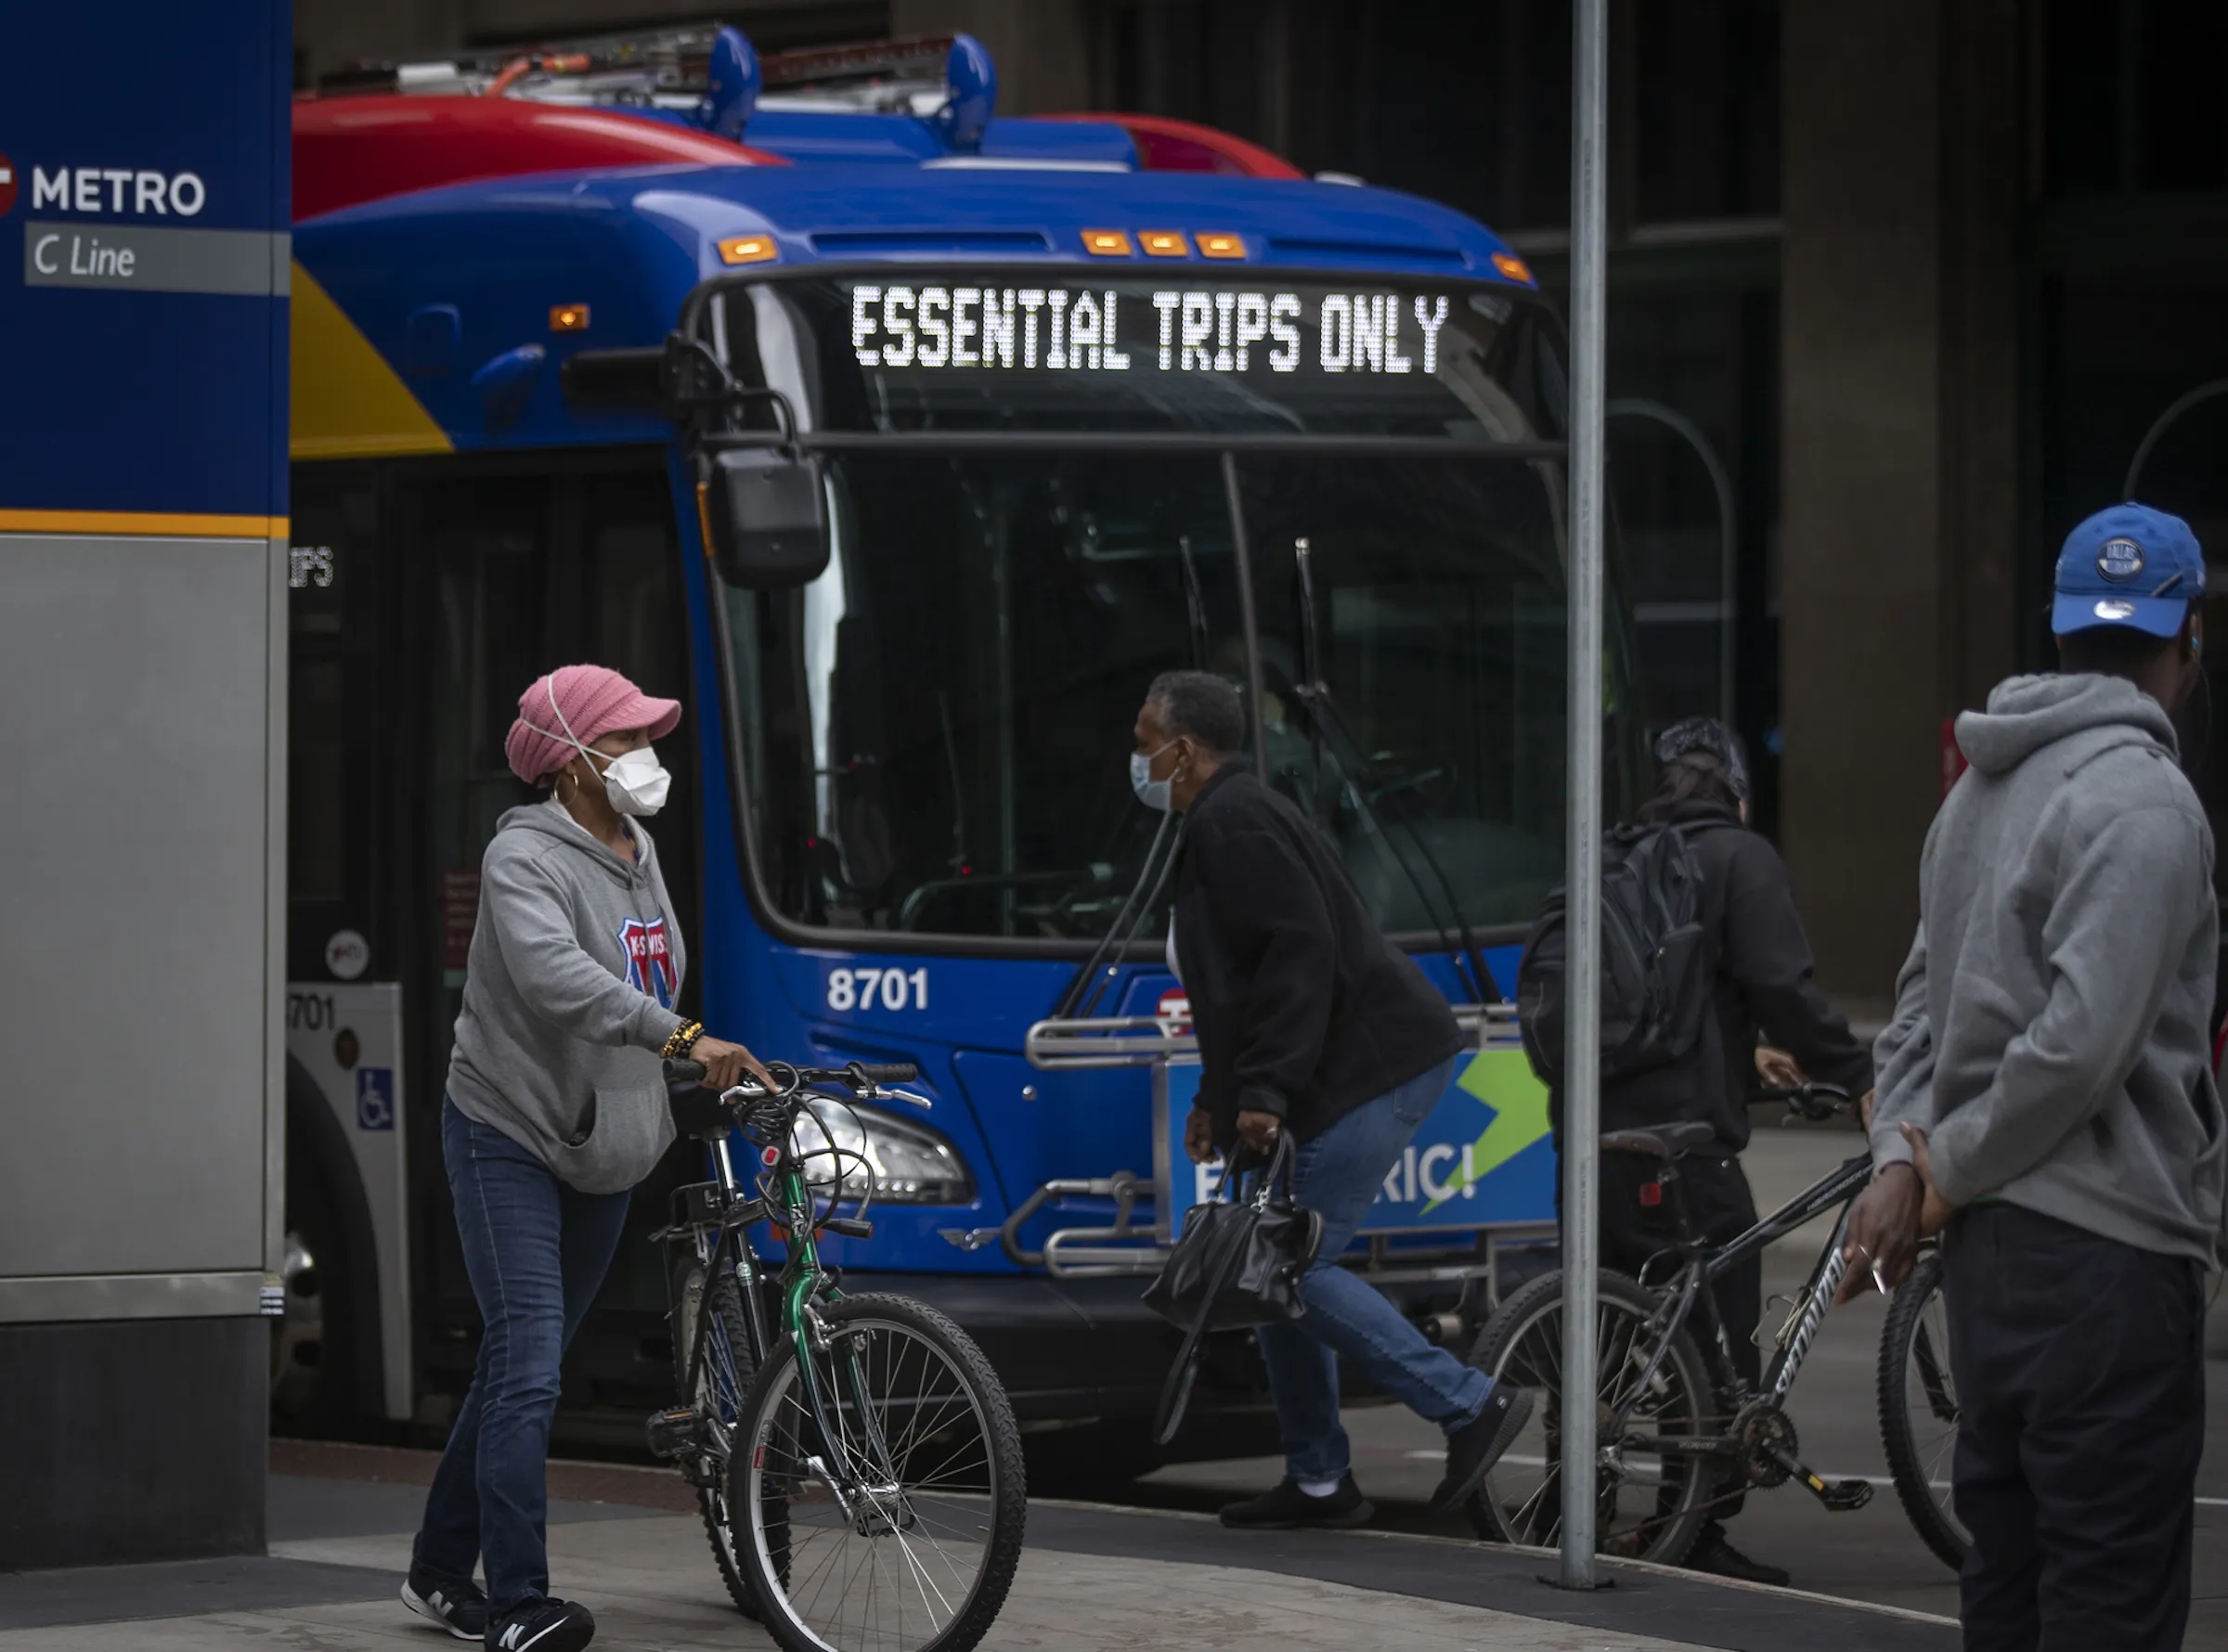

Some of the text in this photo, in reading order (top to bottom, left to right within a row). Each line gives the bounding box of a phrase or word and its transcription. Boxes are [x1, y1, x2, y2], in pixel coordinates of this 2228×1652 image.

[32, 165, 205, 215] METRO
[34, 234, 135, 277] C Line
[852, 286, 1449, 373] ESSENTIAL TRIPS ONLY
[827, 967, 927, 1011] 8701
[287, 993, 334, 1030] 701
